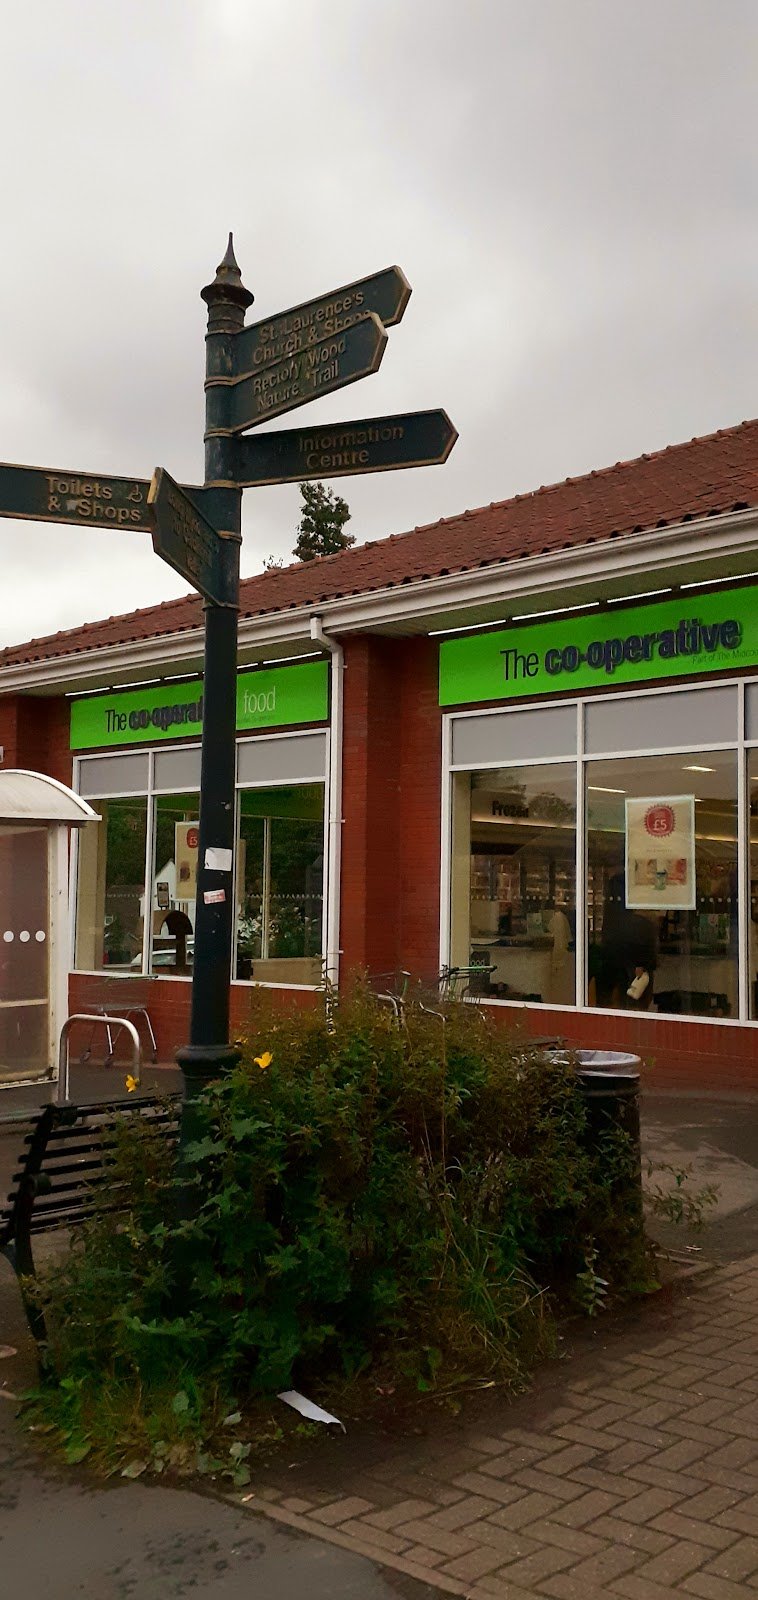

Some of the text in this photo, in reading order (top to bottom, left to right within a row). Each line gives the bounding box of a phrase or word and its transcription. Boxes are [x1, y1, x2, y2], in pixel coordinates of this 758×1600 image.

[259, 291, 364, 344] St. Laurence's
[253, 332, 302, 365] Church
[308, 326, 318, 344] &
[253, 334, 347, 397] Rectory Wood
[257, 360, 338, 414] Nature Trail
[300, 425, 404, 452] Information
[306, 450, 370, 470] Centre
[45, 476, 112, 500] Toilets
[48, 495, 141, 523] & Shops
[500, 618, 742, 681] The co-operative
[105, 709, 127, 733] The
[243, 686, 276, 715] food
[653, 817, 667, 831] £5
